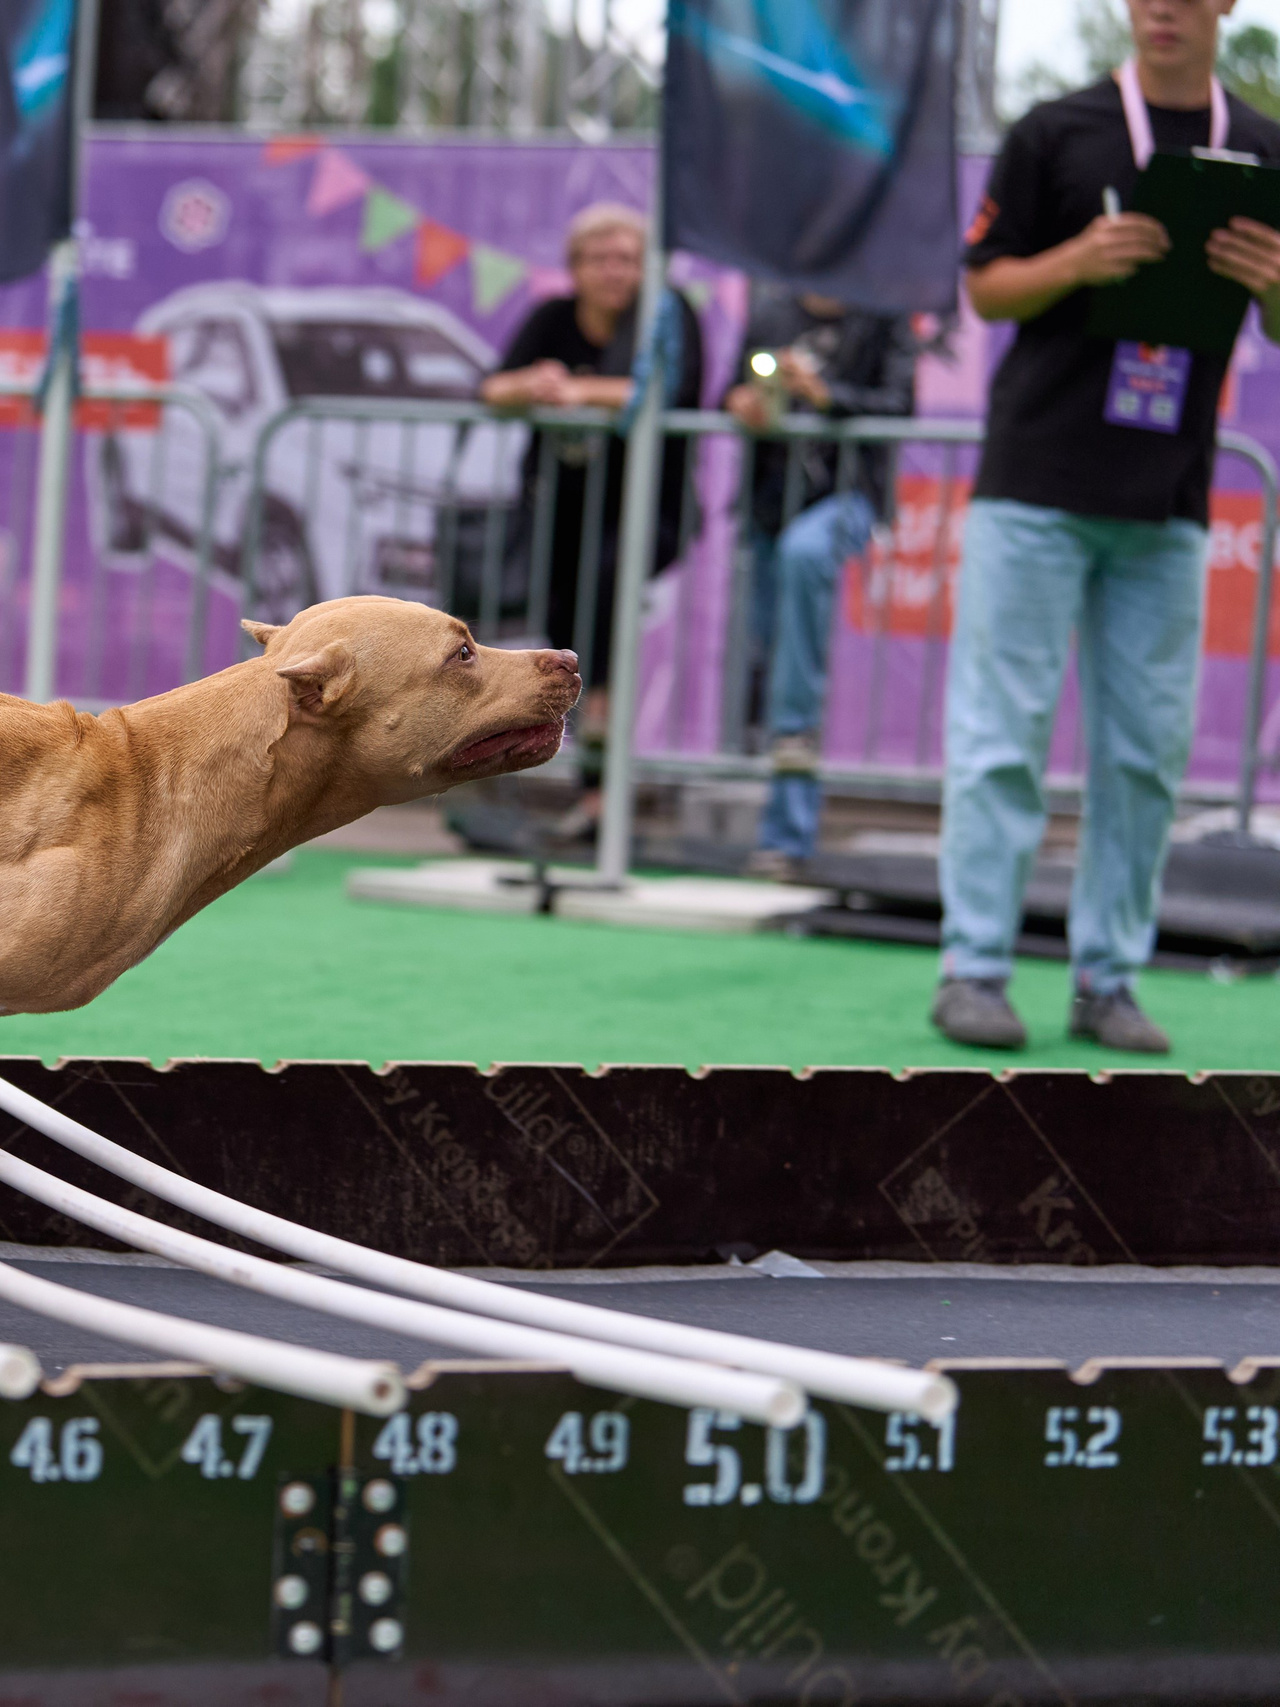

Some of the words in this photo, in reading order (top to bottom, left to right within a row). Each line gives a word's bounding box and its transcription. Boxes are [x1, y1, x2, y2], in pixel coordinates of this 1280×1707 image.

[10, 1416, 104, 1483] 4.6
[181, 1412, 273, 1480] 4.7
[373, 1411, 458, 1475] 4.8
[545, 1410, 630, 1473] 4.9
[683, 1407, 827, 1506] 5.0
[883, 1411, 957, 1472] 5.1
[1044, 1407, 1122, 1469] 5.2
[1201, 1405, 1280, 1467] 5.3
